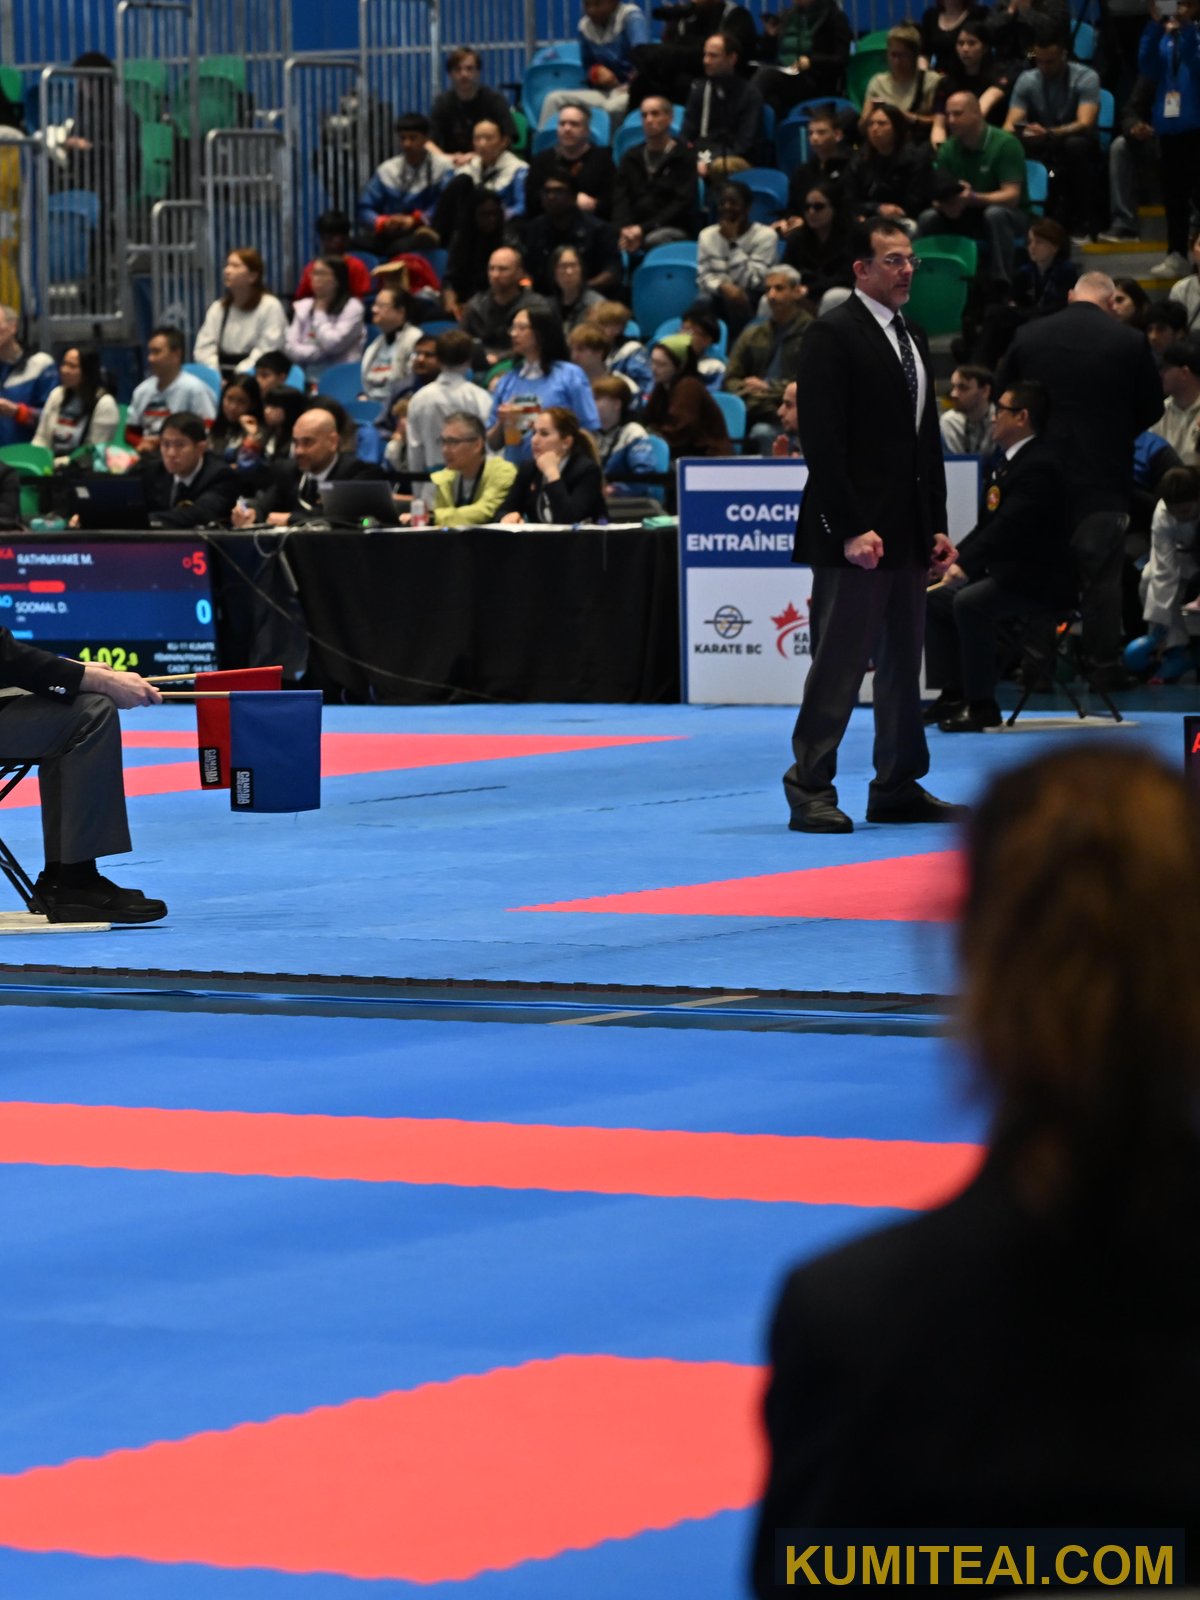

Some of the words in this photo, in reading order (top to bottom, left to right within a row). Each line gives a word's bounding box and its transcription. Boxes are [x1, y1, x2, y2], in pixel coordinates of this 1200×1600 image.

[726, 504, 799, 521] COACH
[196, 599, 212, 624] 0
[695, 645, 742, 654] KARATE
[746, 645, 762, 654] BC
